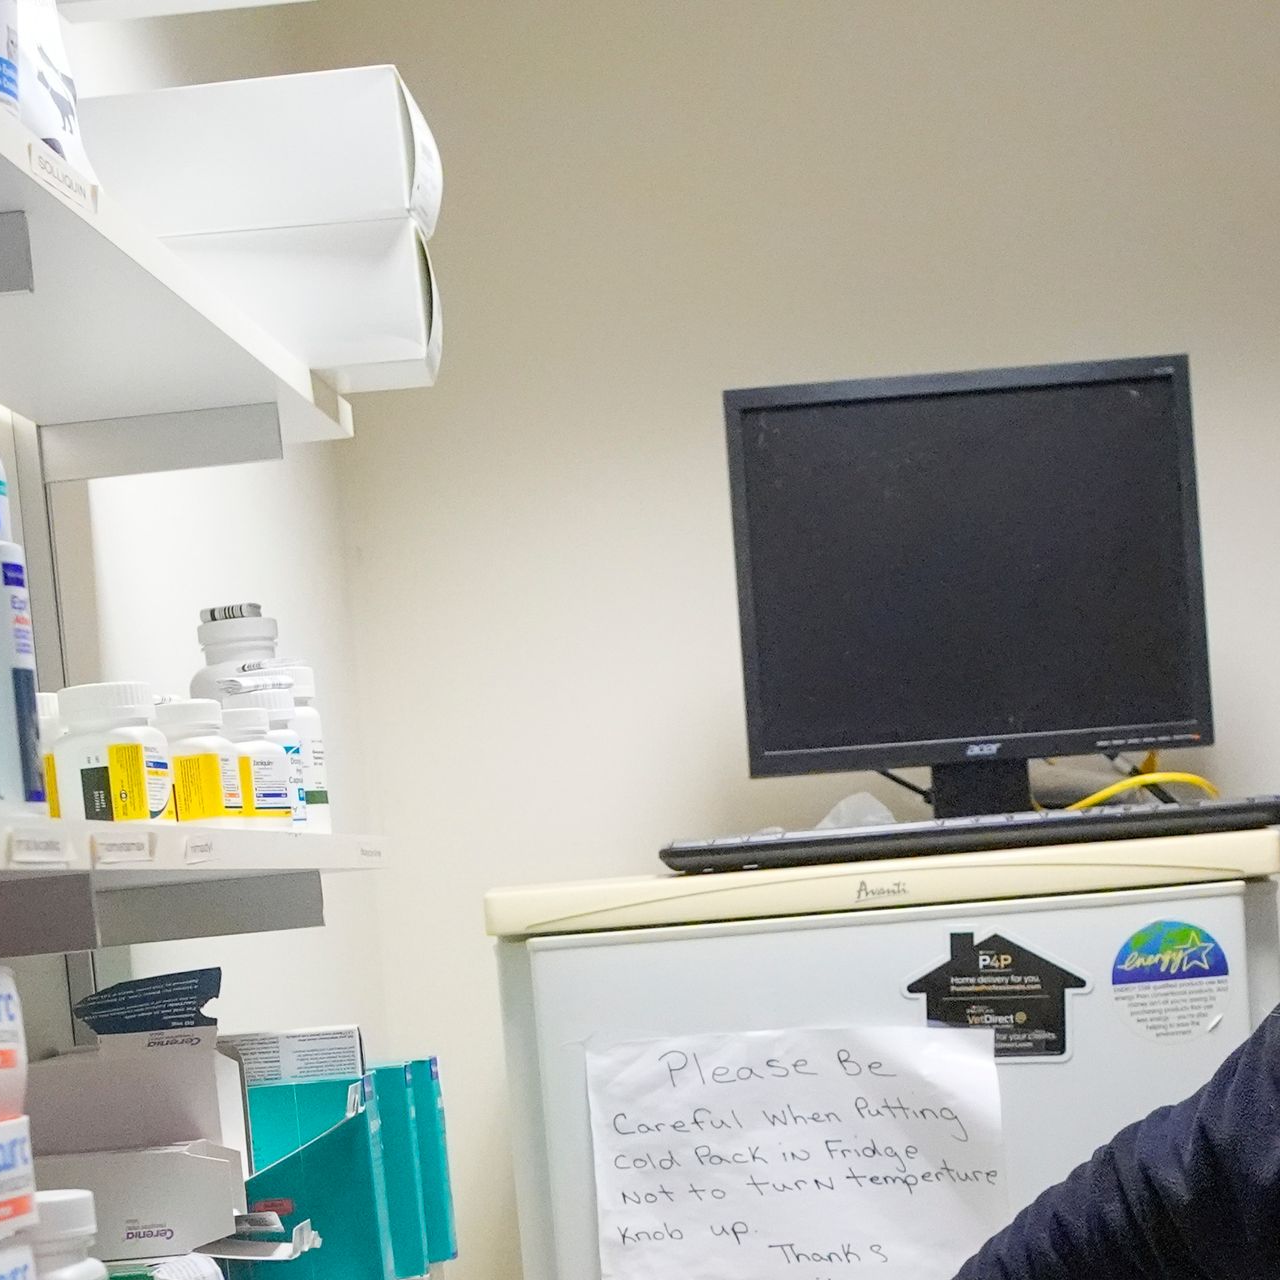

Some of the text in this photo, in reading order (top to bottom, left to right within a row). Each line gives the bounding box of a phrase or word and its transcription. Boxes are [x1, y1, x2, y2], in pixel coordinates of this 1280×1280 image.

[38, 156, 87, 199] SOLLIQUIN
[966, 743, 1002, 756] acer
[857, 880, 909, 899] Avanti
[978, 954, 1013, 969] P4P
[147, 1035, 202, 1049] Cerenia
[658, 1049, 897, 1088] Please Be
[613, 1108, 745, 1137] Careful
[824, 1139, 920, 1173] Fridge
[688, 1182, 727, 1202] to
[125, 1227, 175, 1241] Cerenia
